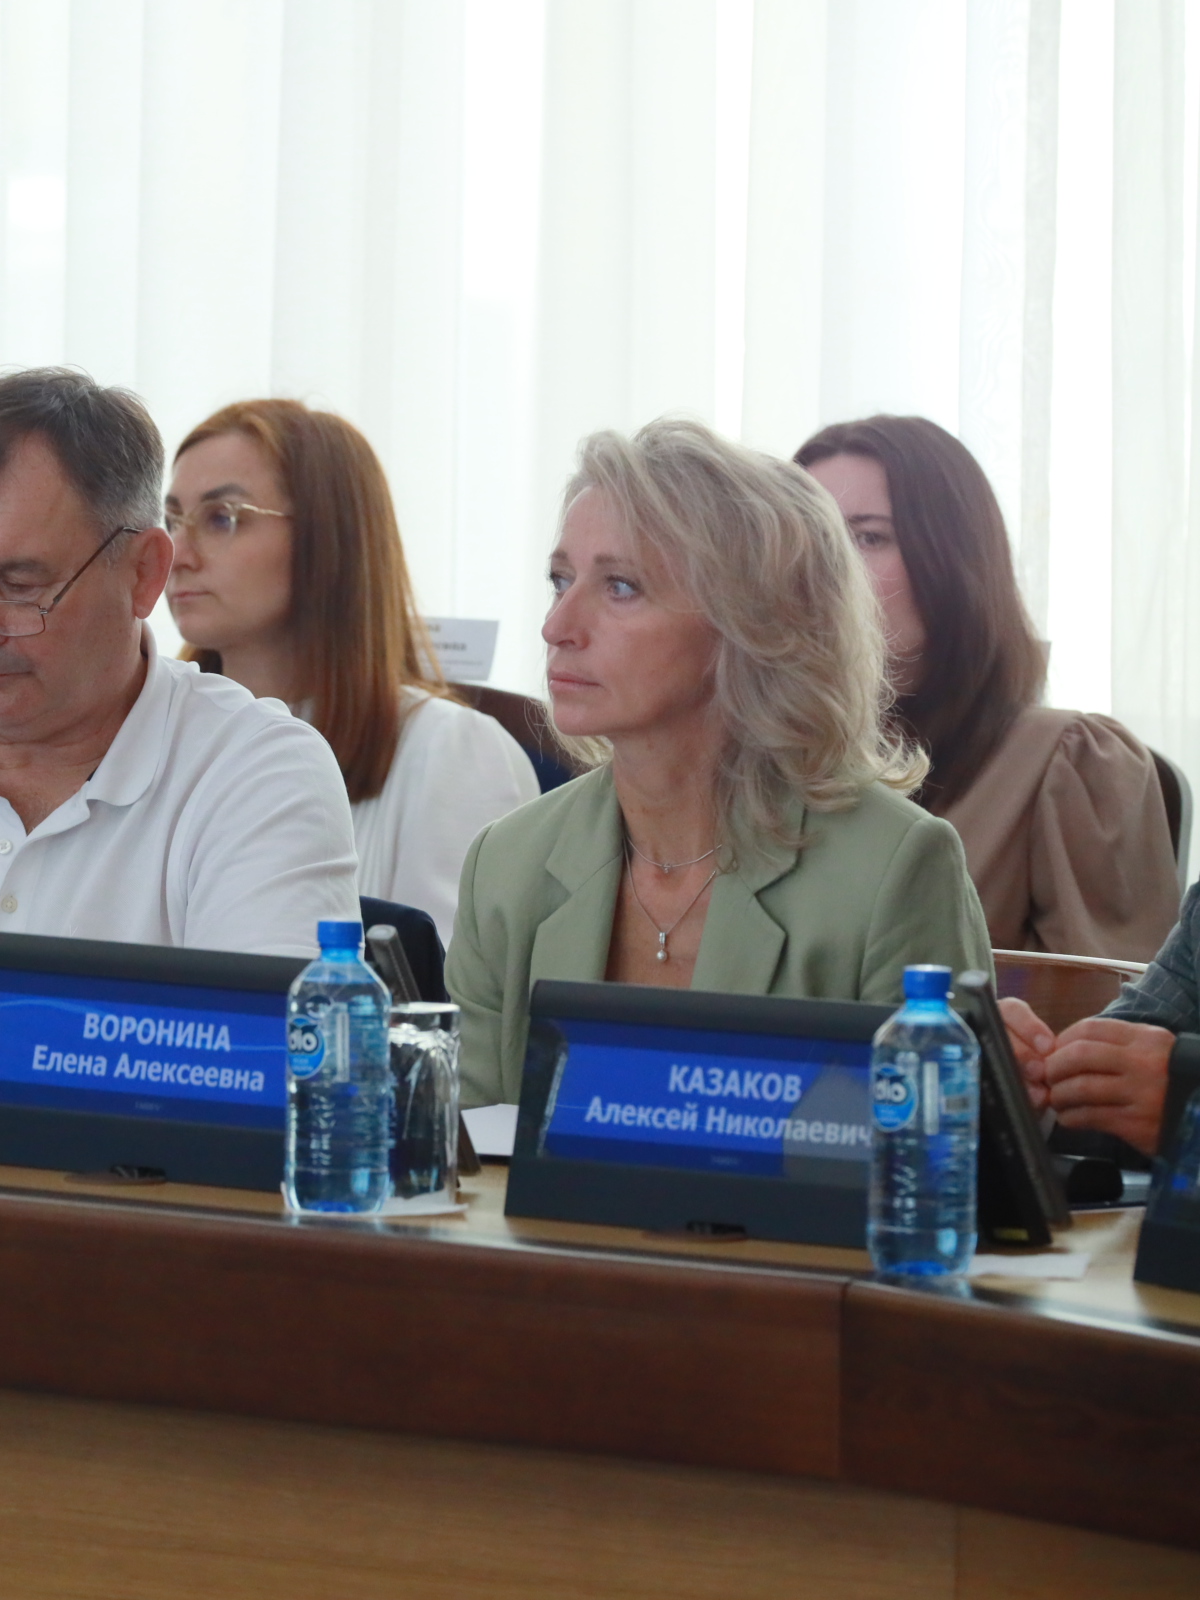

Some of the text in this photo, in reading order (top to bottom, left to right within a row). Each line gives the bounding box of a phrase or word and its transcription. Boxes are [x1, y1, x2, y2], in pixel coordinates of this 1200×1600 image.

[83, 1012, 231, 1052] ВОРОНИНА
[32, 1044, 265, 1092] Елена Алексеевна
[668, 1064, 803, 1103] КАЗАКОВ
[584, 1096, 873, 1147] Алексей Николаевич
